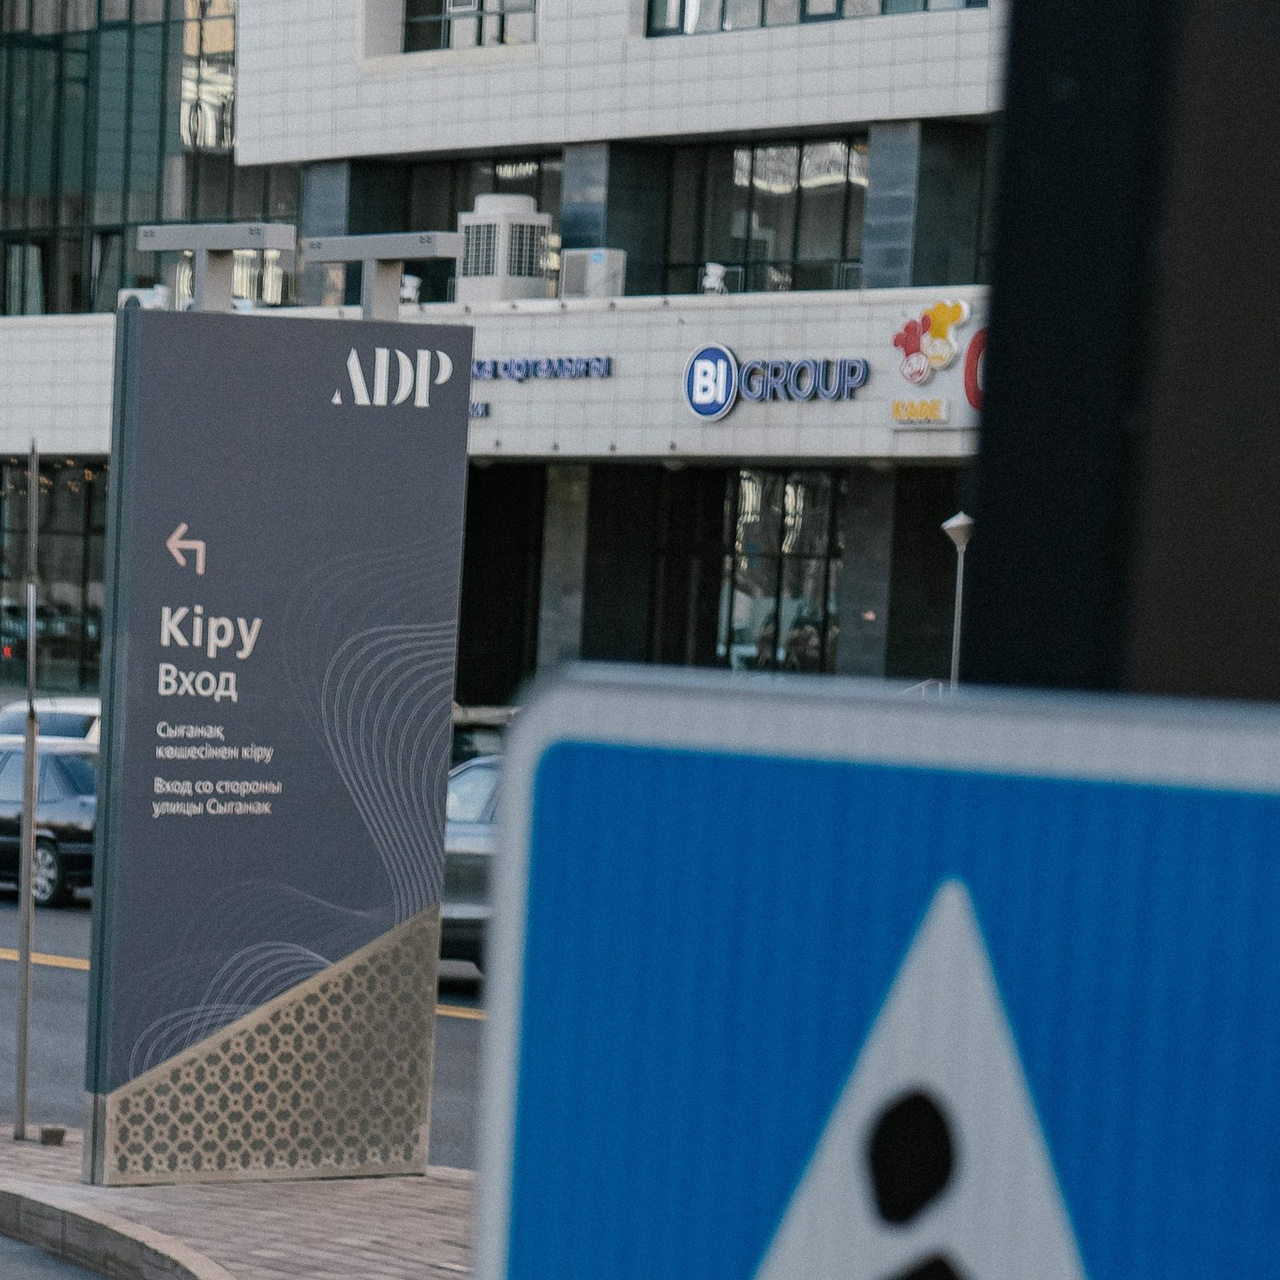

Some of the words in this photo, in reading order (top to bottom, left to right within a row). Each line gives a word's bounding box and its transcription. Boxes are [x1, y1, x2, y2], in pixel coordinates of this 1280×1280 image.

[331, 347, 453, 408] ADP
[692, 358, 727, 405] BI
[738, 358, 868, 402] GROUP
[161, 605, 263, 659] Кіру
[158, 663, 238, 702] Вход
[154, 777, 193, 797] Вход
[195, 780, 214, 794] со
[215, 780, 283, 797] стороны
[152, 801, 204, 819] улицы
